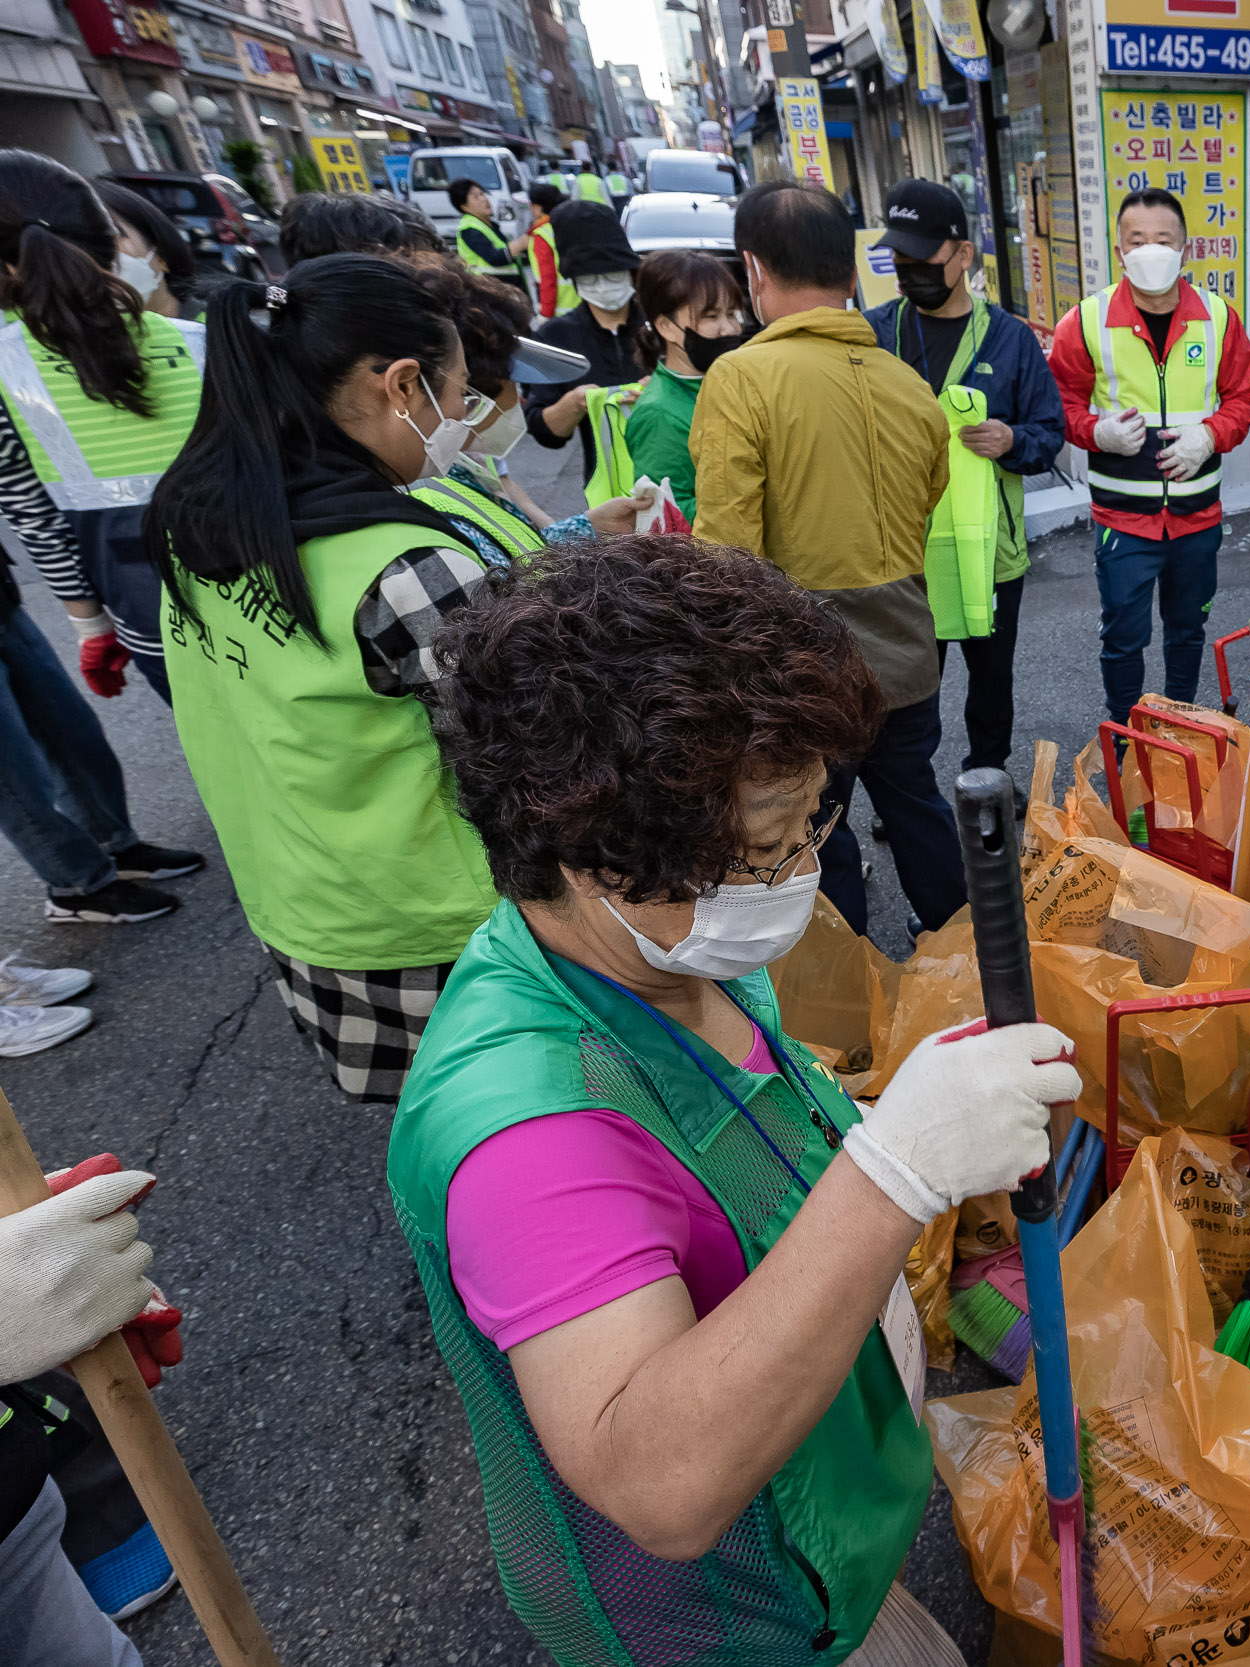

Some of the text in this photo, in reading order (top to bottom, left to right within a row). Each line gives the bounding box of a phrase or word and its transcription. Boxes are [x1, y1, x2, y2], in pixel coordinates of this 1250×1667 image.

[1125, 101, 1223, 130] 신축빌라
[800, 135, 825, 186] 부동
[1126, 138, 1223, 163] 오피스텔
[1207, 203, 1226, 226] 가
[1188, 237, 1237, 259] 울지역)
[1095, 1517, 1128, 1548] 배출장
